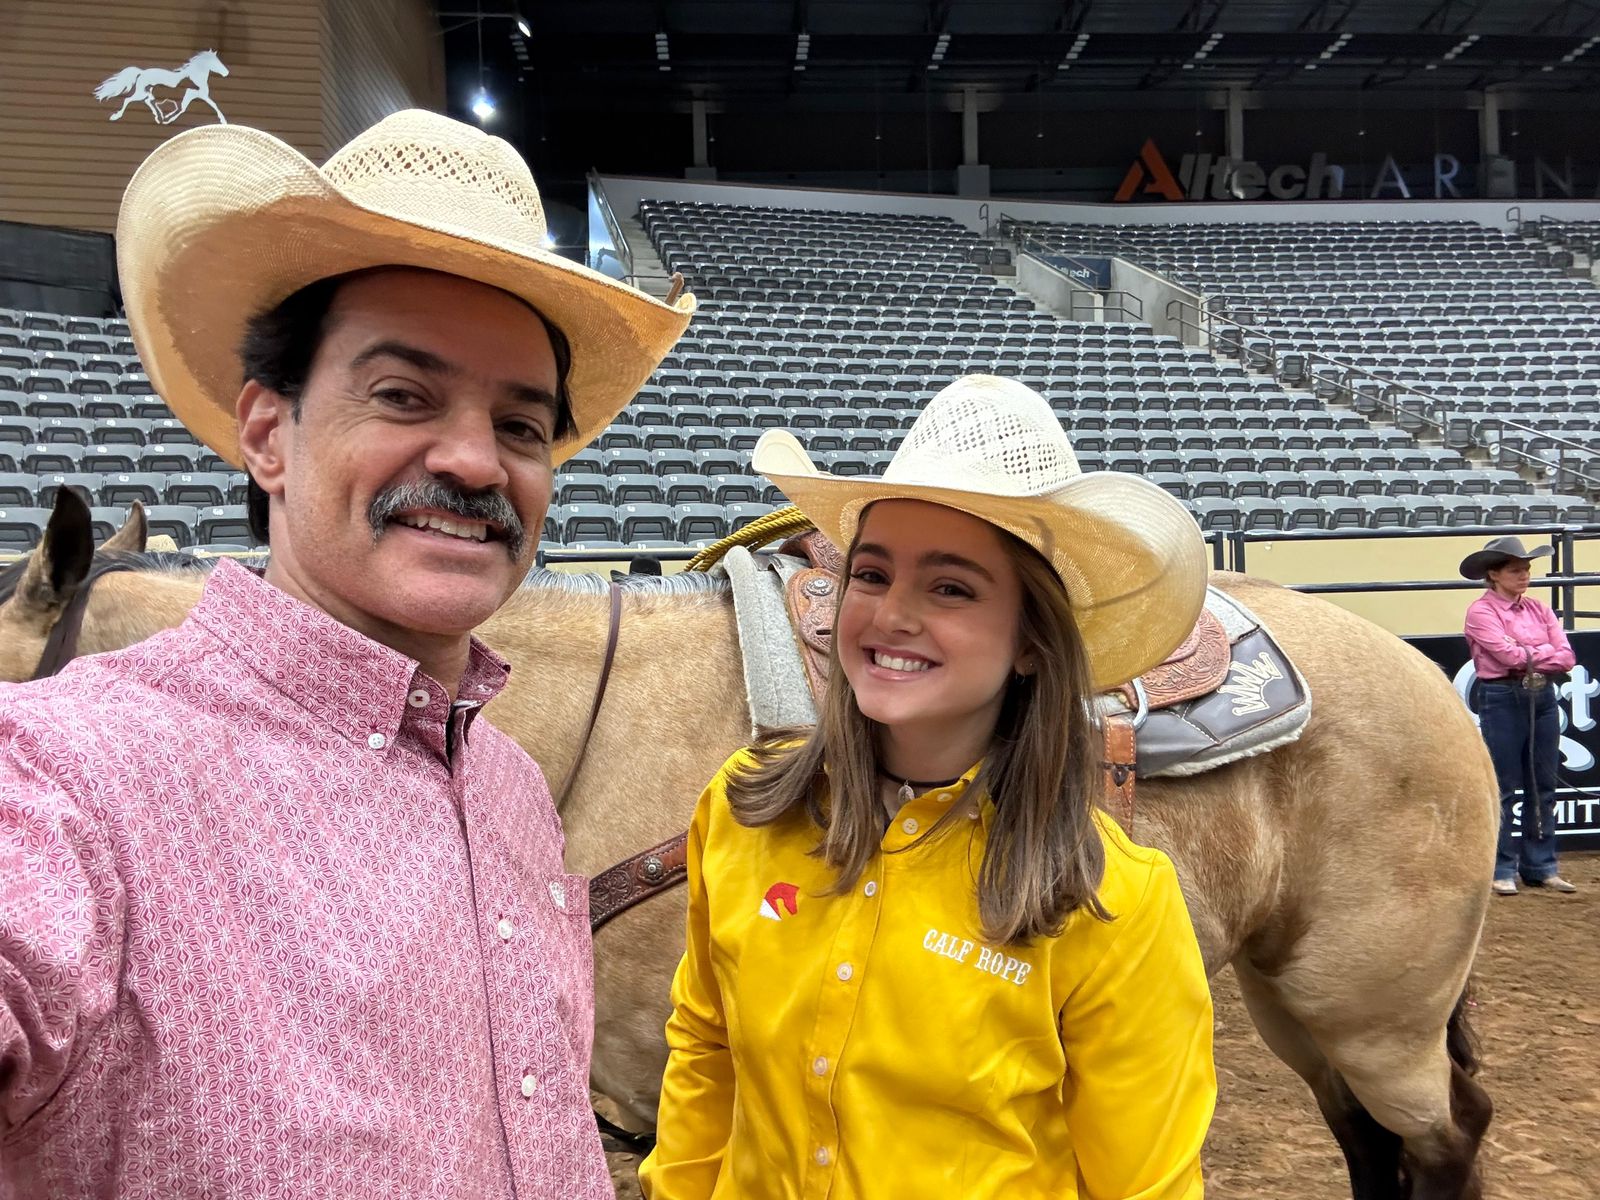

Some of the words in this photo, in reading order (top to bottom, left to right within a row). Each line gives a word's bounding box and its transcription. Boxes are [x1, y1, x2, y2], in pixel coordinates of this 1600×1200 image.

[1113, 137, 1345, 201] Alltech
[1370, 152, 1600, 200] ARN
[922, 928, 975, 963] CALF
[973, 946, 1032, 985] ROPE
